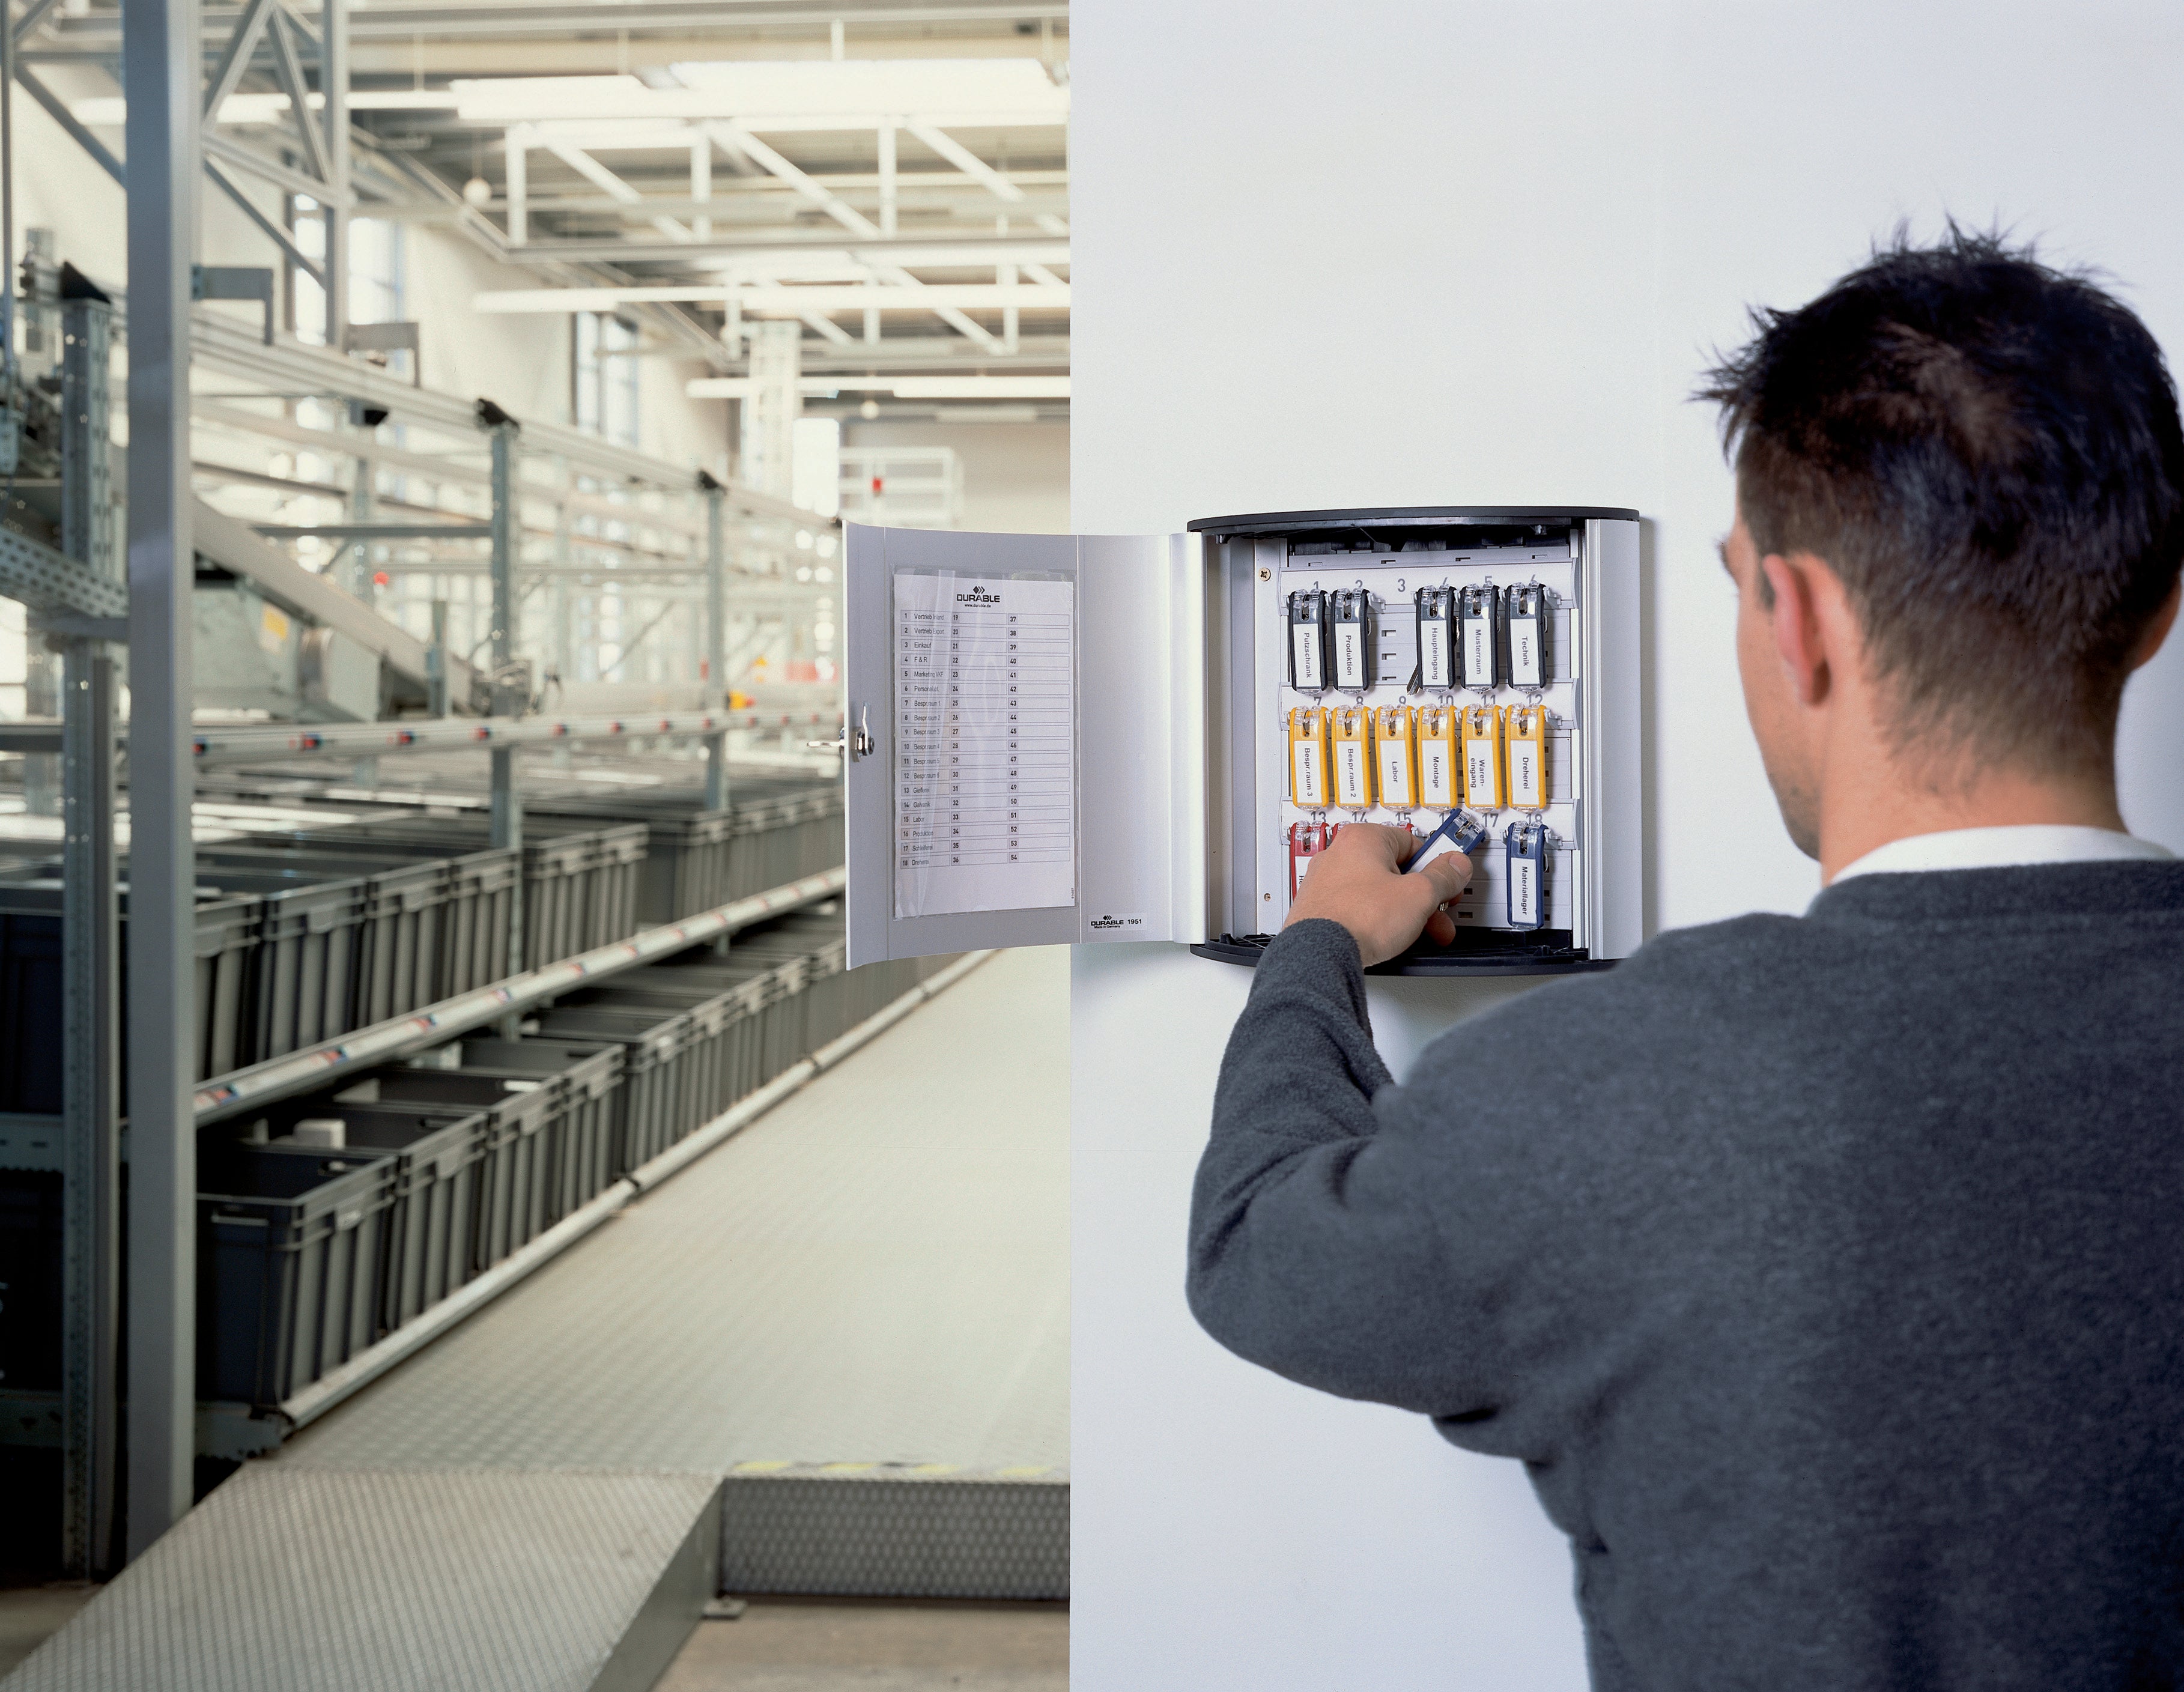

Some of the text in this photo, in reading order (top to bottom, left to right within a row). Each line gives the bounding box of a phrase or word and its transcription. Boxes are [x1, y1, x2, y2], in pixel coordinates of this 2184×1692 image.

[1397, 578, 1406, 592] 3
[956, 593, 1000, 602] DURABLE
[1303, 632, 1312, 678] Putzschrank
[1481, 694, 1496, 705] 11
[1526, 694, 1542, 705] 12
[1311, 811, 1326, 823] 13
[1395, 812, 1412, 823] 15
[1482, 813, 1499, 828] 17
